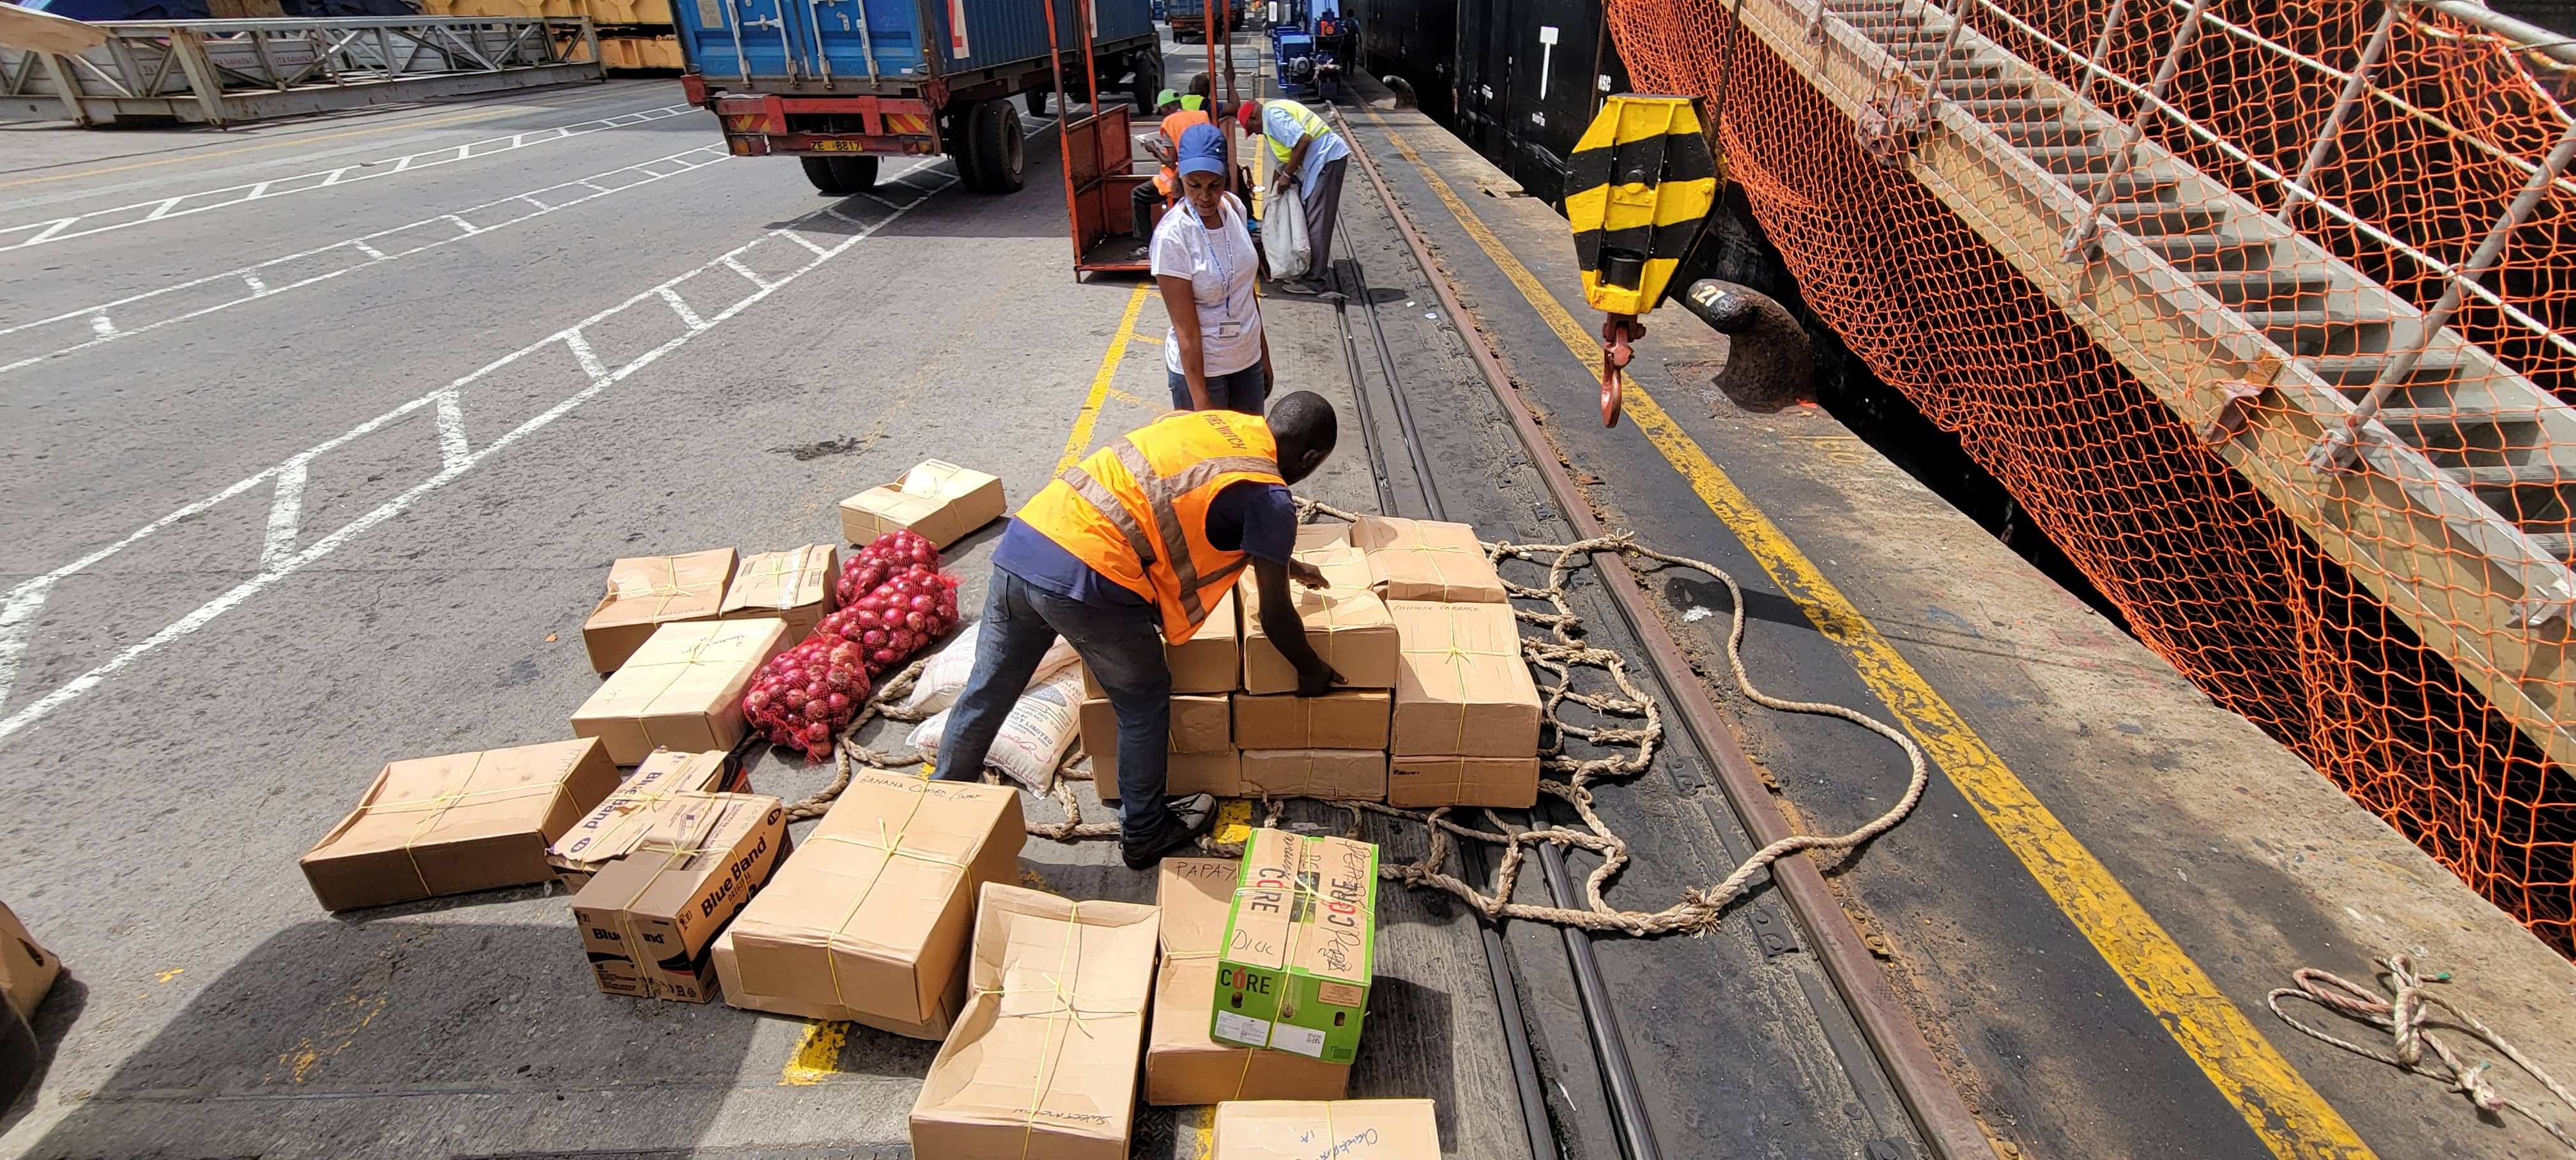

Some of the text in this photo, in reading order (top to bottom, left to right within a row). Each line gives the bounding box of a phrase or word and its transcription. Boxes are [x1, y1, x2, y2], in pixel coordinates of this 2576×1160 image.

[1202, 414, 1248, 450] FIRE WATCH
[1025, 719, 1054, 745] LIMITED
[701, 878, 733, 919] Blue
[731, 836, 767, 882] Band
[1175, 862, 1238, 881] PAPAY
